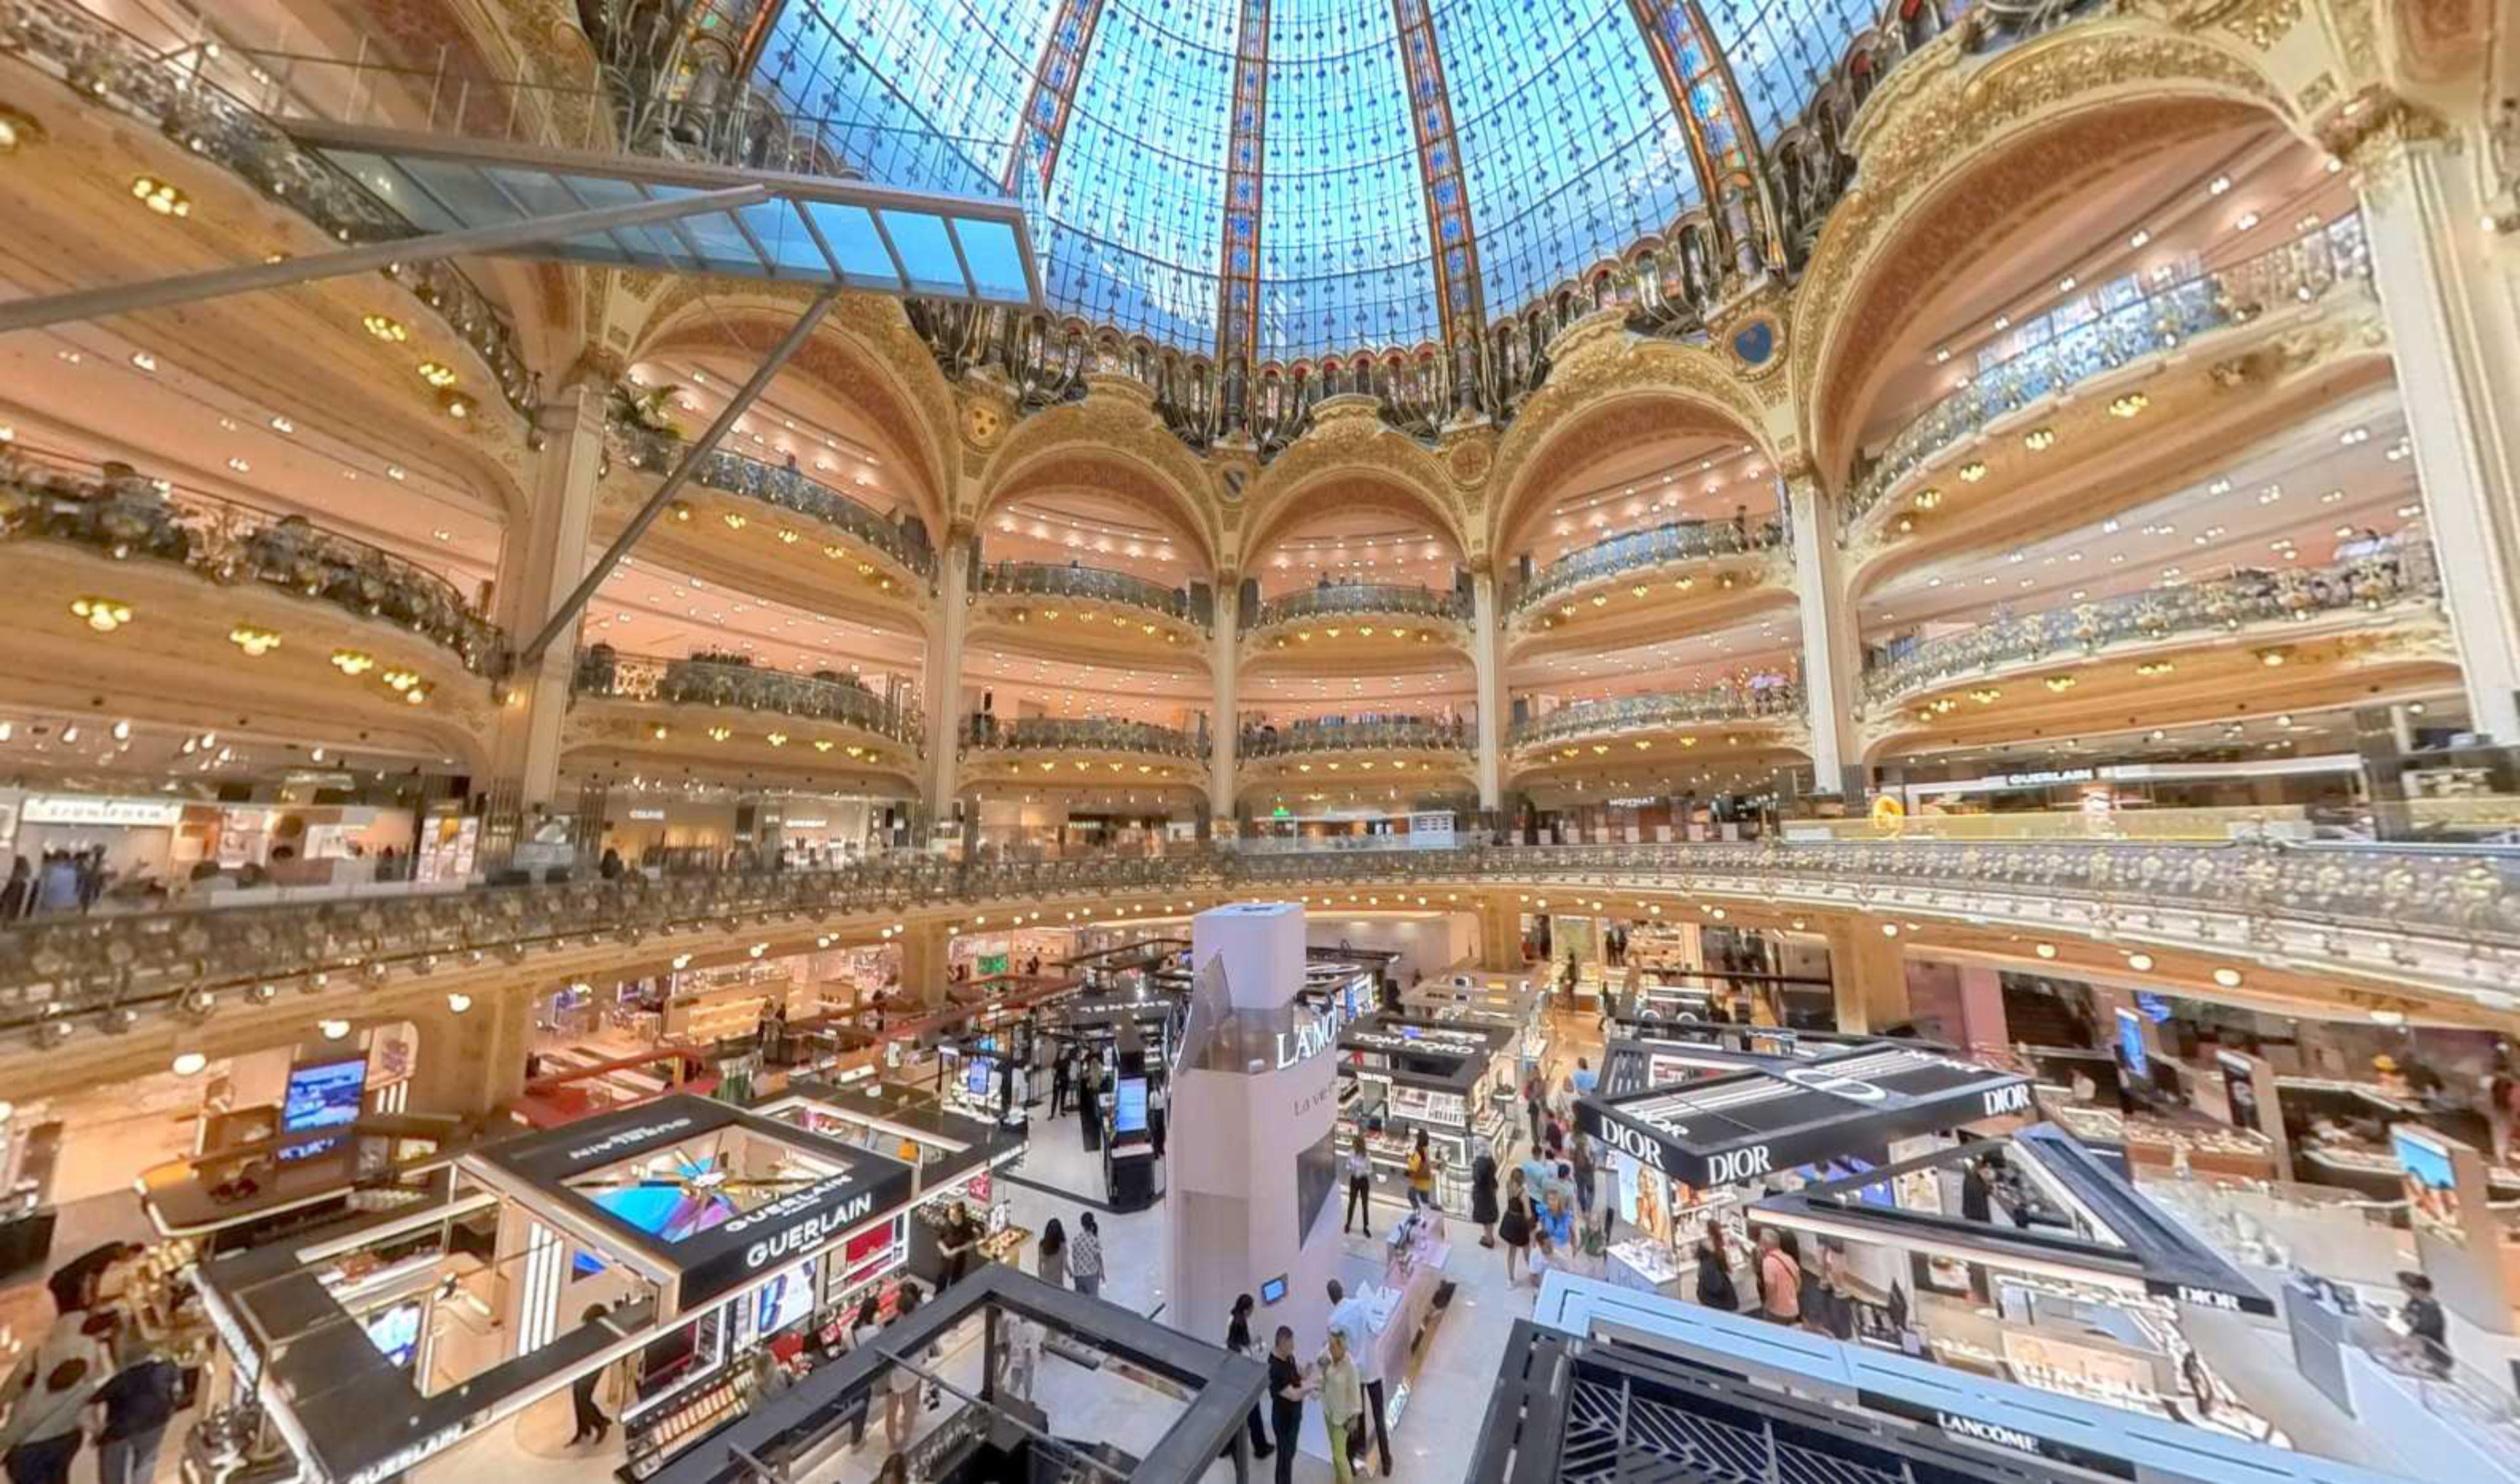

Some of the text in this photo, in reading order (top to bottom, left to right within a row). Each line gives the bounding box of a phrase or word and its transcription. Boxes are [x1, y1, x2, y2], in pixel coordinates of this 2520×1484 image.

[2009, 768, 2092, 785] GUERLAIN
[1984, 1083, 2032, 1116] DIOR
[1601, 1115, 1665, 1170] DIOR
[1708, 1145, 1772, 1185] DIOR
[725, 1174, 852, 1232] GUERLAIN
[747, 1193, 872, 1268] GUERLAIN
[2177, 1285, 2243, 1312] DIOR
